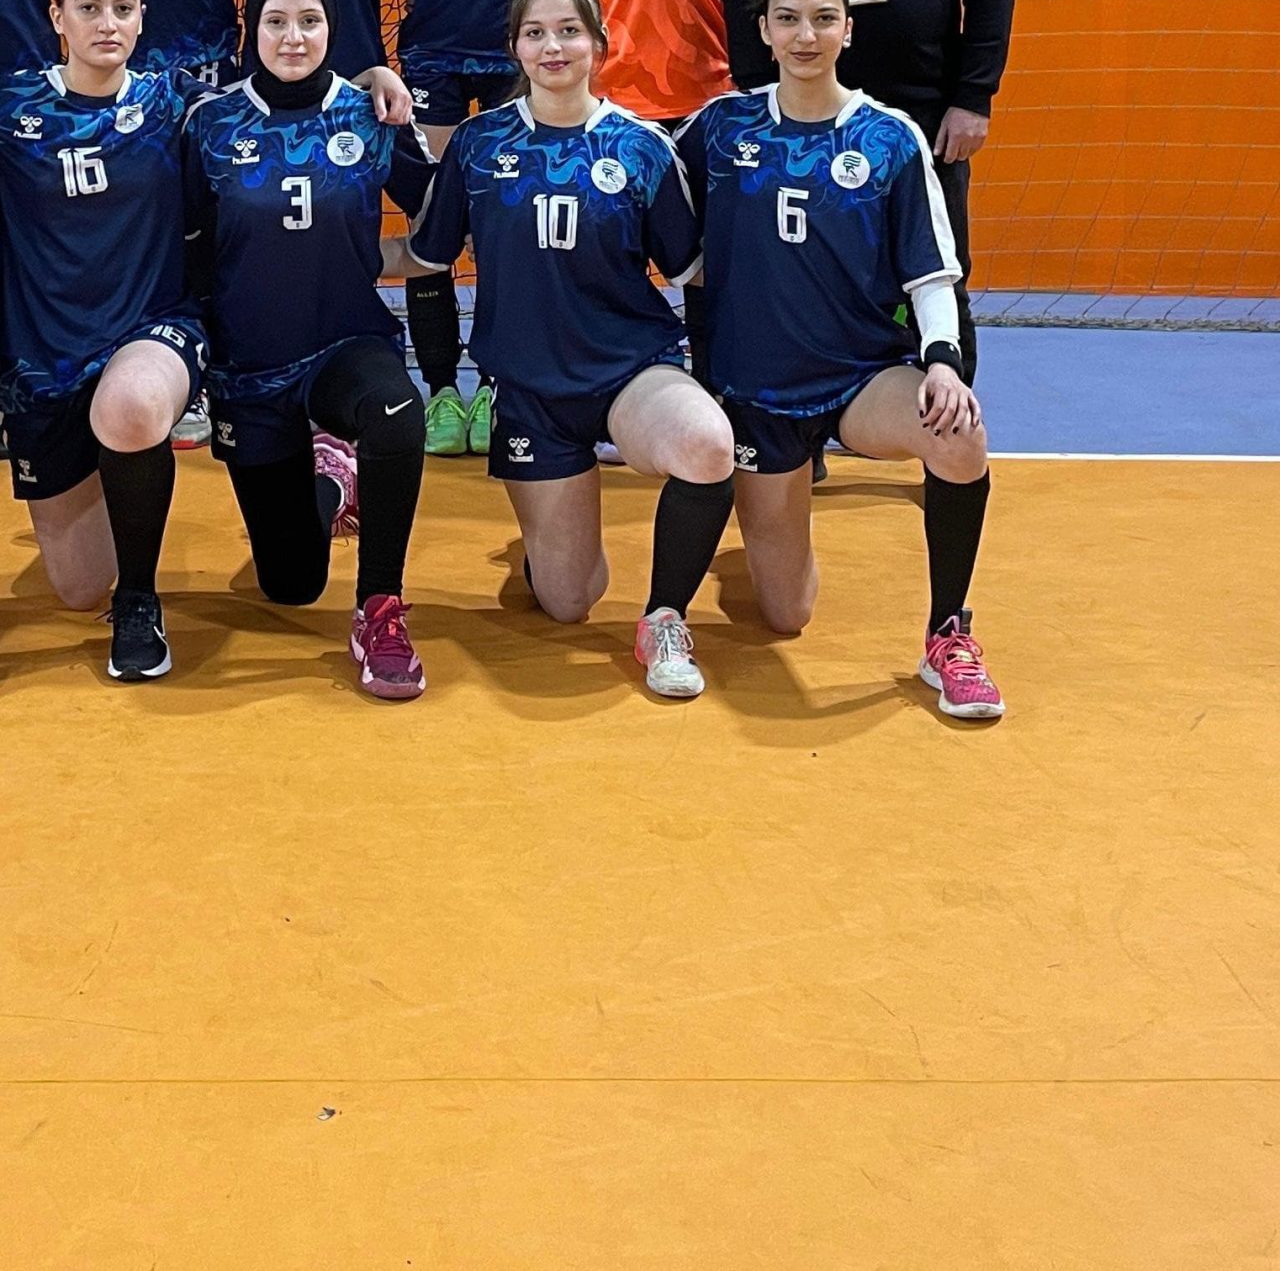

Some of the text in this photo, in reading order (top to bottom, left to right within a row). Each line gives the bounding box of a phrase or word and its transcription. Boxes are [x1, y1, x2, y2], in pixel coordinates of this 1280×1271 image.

[57, 146, 108, 198] 16
[281, 176, 313, 230] 3
[533, 193, 579, 250] 10
[777, 186, 809, 243] 6
